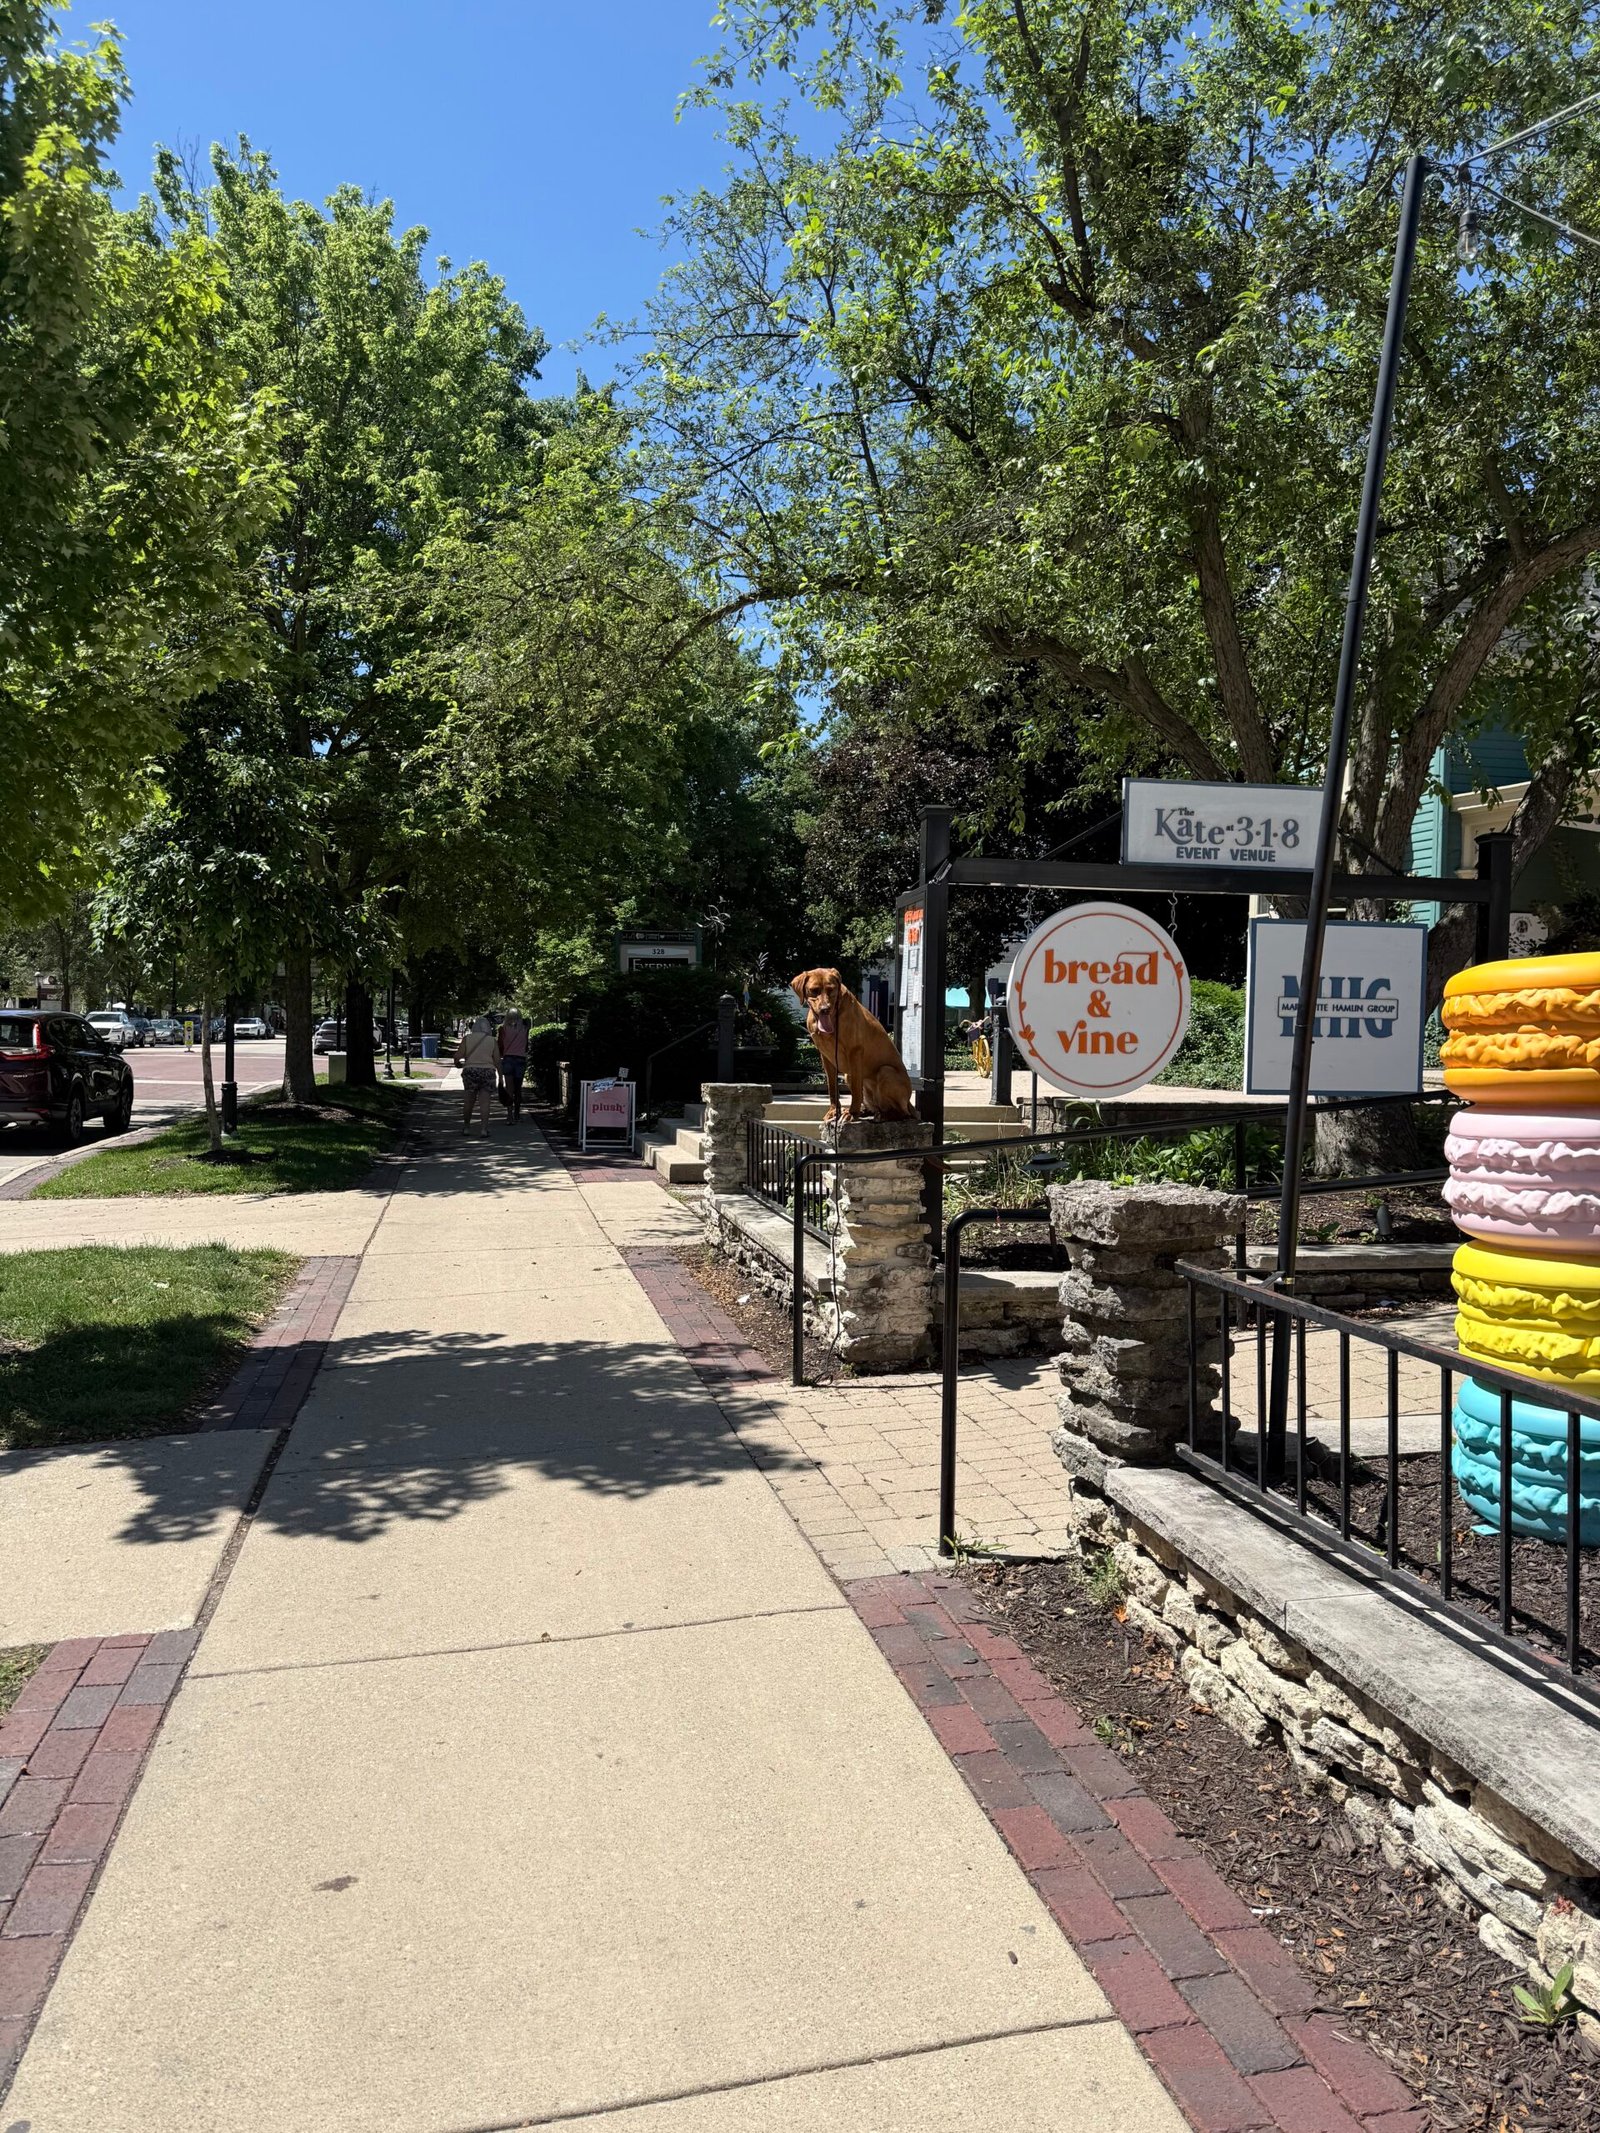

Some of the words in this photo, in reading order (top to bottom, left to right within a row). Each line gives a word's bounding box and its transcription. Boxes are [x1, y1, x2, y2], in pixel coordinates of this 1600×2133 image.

[1178, 807, 1195, 816] The
[1154, 808, 1225, 845] Kate
[1225, 824, 1234, 832] at
[1176, 846, 1221, 860] EVENT
[1230, 848, 1276, 862] VENUE
[1044, 948, 1158, 985] bread
[1087, 990, 1111, 1018] &
[1332, 1003, 1364, 1012] HAMLIN
[1367, 1004, 1396, 1013] GROUP
[1057, 1020, 1139, 1054] vine
[592, 1103, 625, 1115] plush
